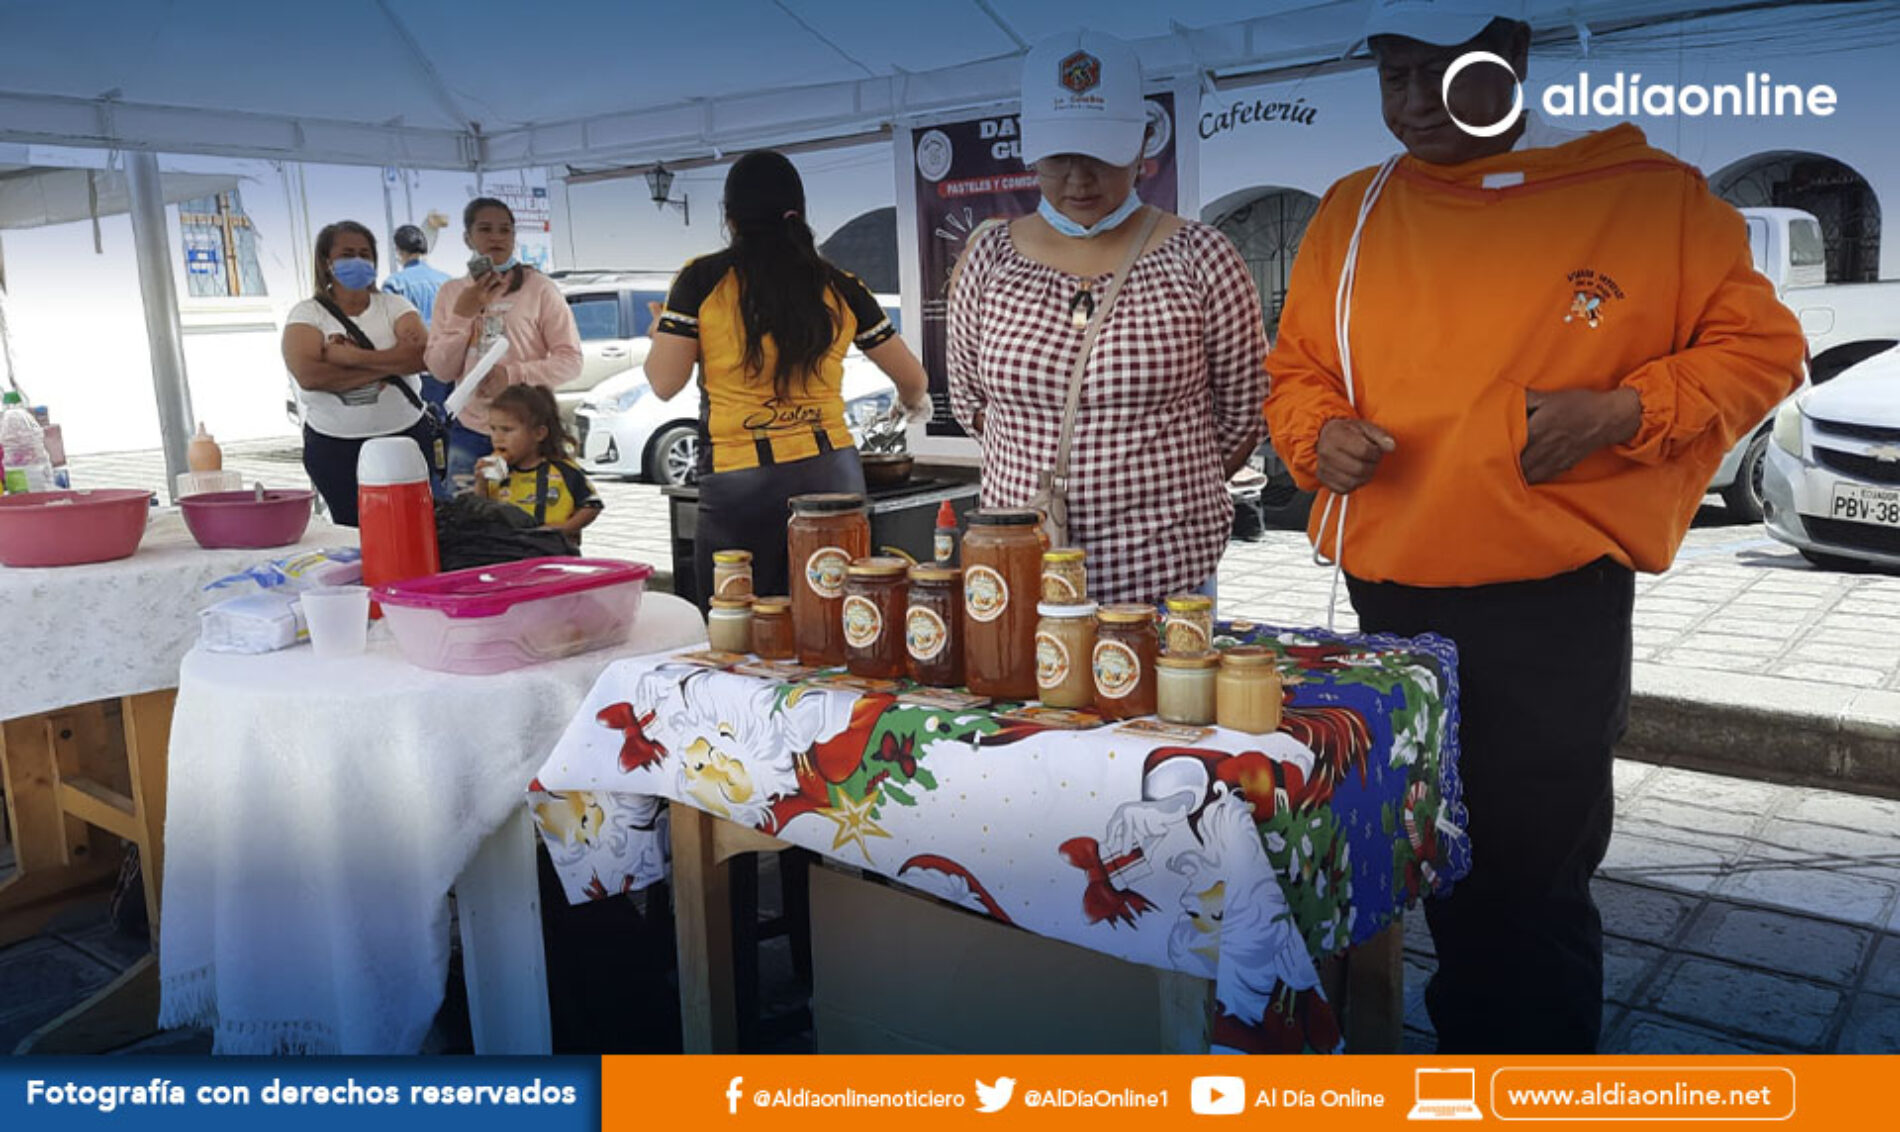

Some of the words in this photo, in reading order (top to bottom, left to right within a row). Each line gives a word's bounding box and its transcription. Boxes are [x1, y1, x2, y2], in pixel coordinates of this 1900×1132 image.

[1199, 98, 1318, 140] Cafetería
[946, 178, 992, 196] PASTELES
[993, 178, 1001, 190] Y
[1834, 496, 1899, 524] PBV-38
